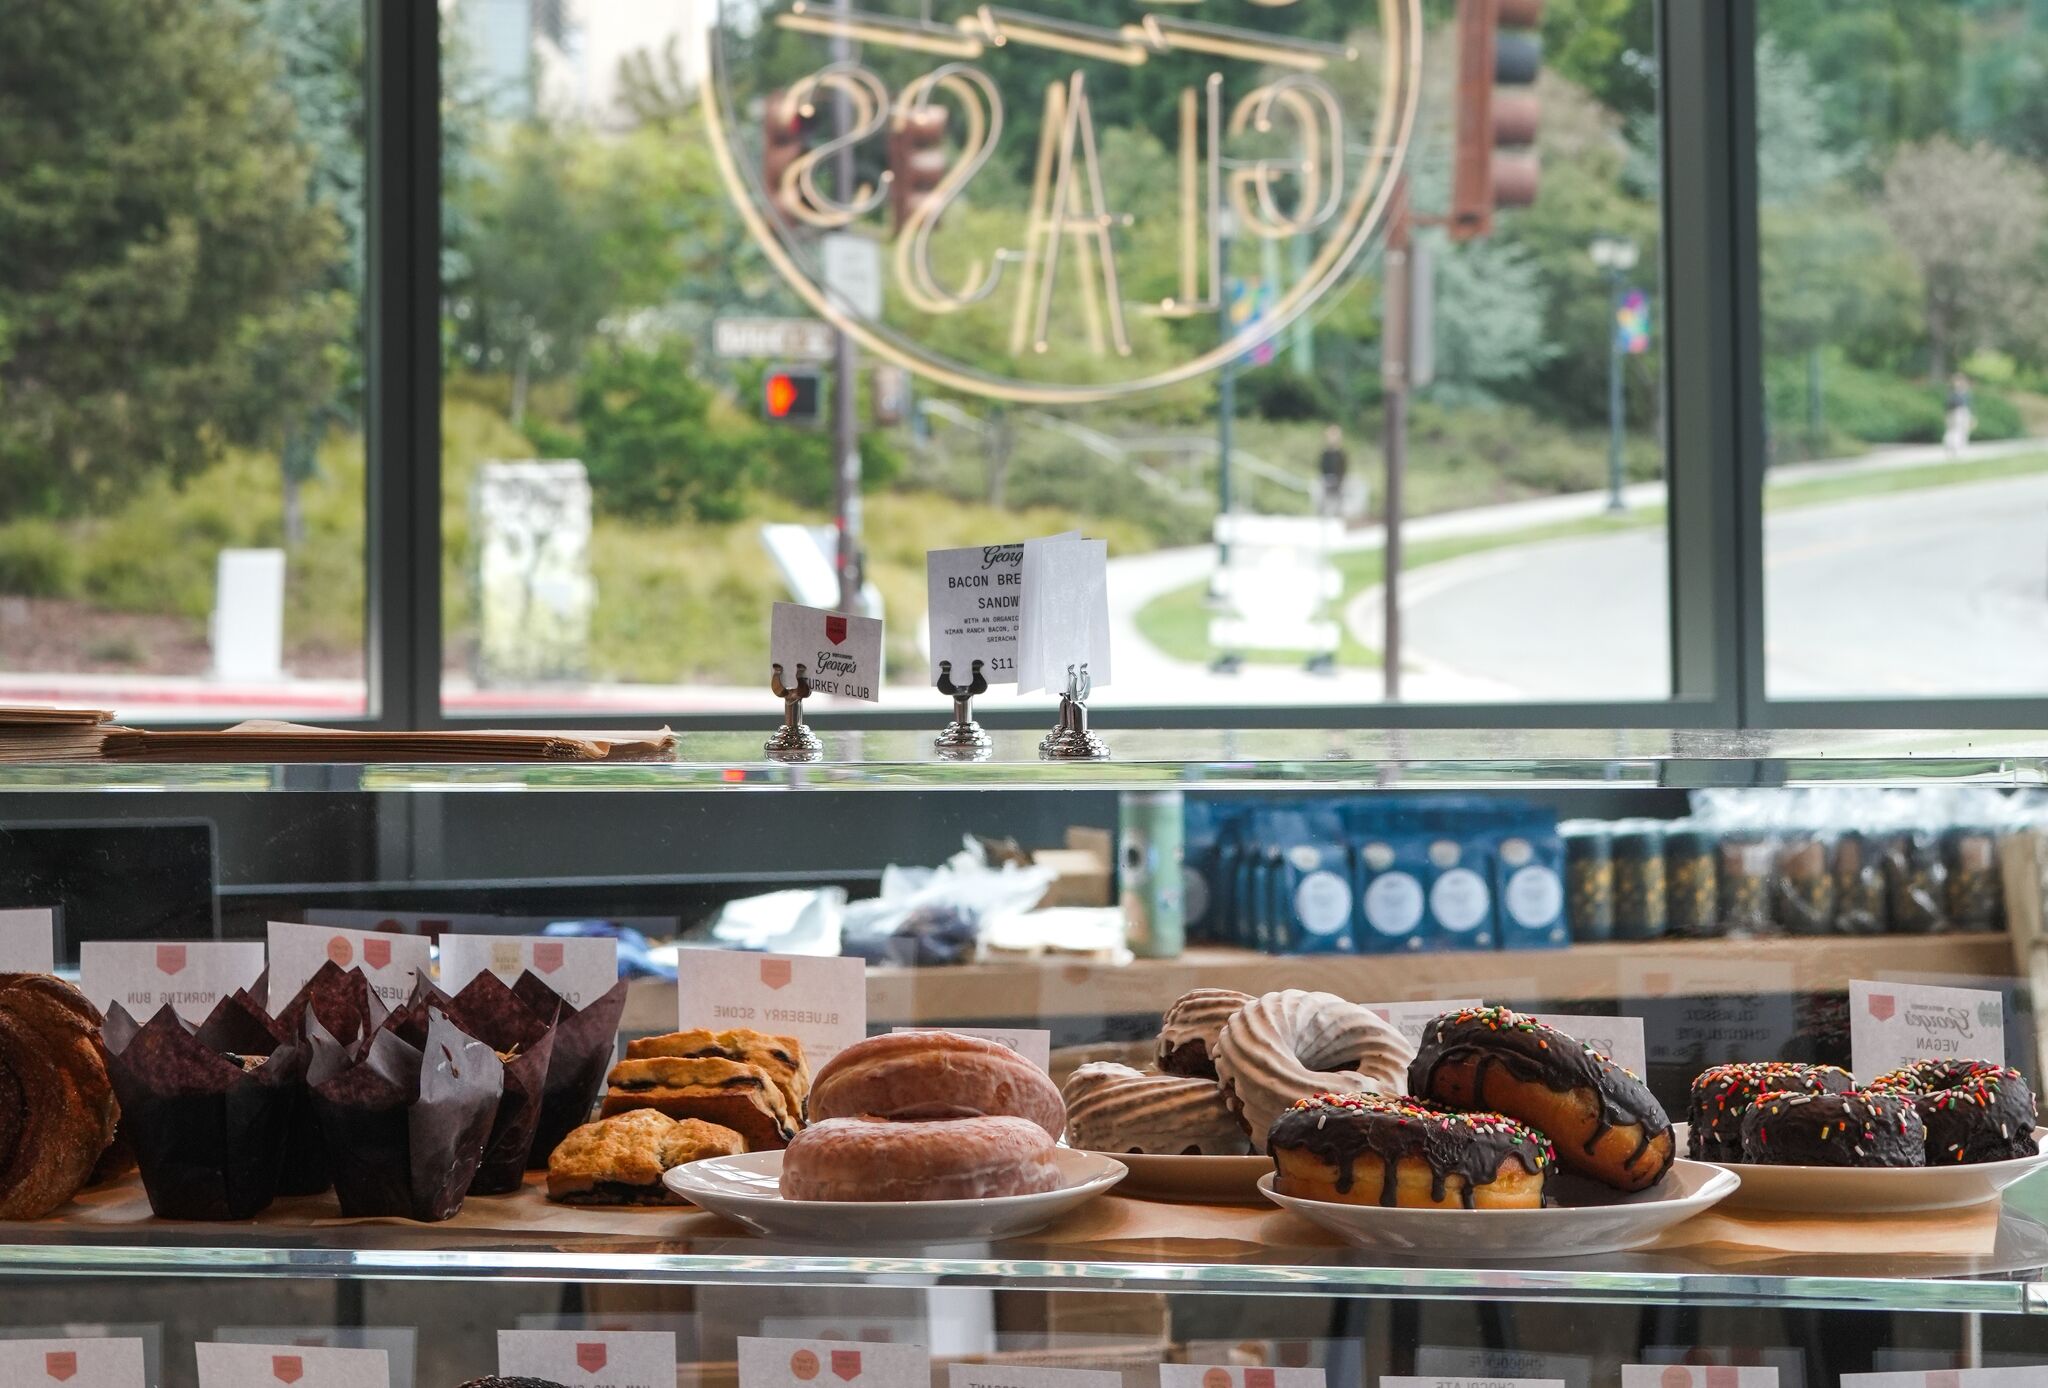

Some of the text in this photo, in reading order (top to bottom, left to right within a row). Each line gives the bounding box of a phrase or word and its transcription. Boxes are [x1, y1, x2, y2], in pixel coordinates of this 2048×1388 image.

[981, 544, 1023, 570] Georg
[948, 575, 989, 588] BACON
[978, 596, 1019, 609] SANDW
[993, 615, 1019, 623] ORGANIC
[815, 651, 857, 677] George's
[844, 684, 869, 699] CLUB
